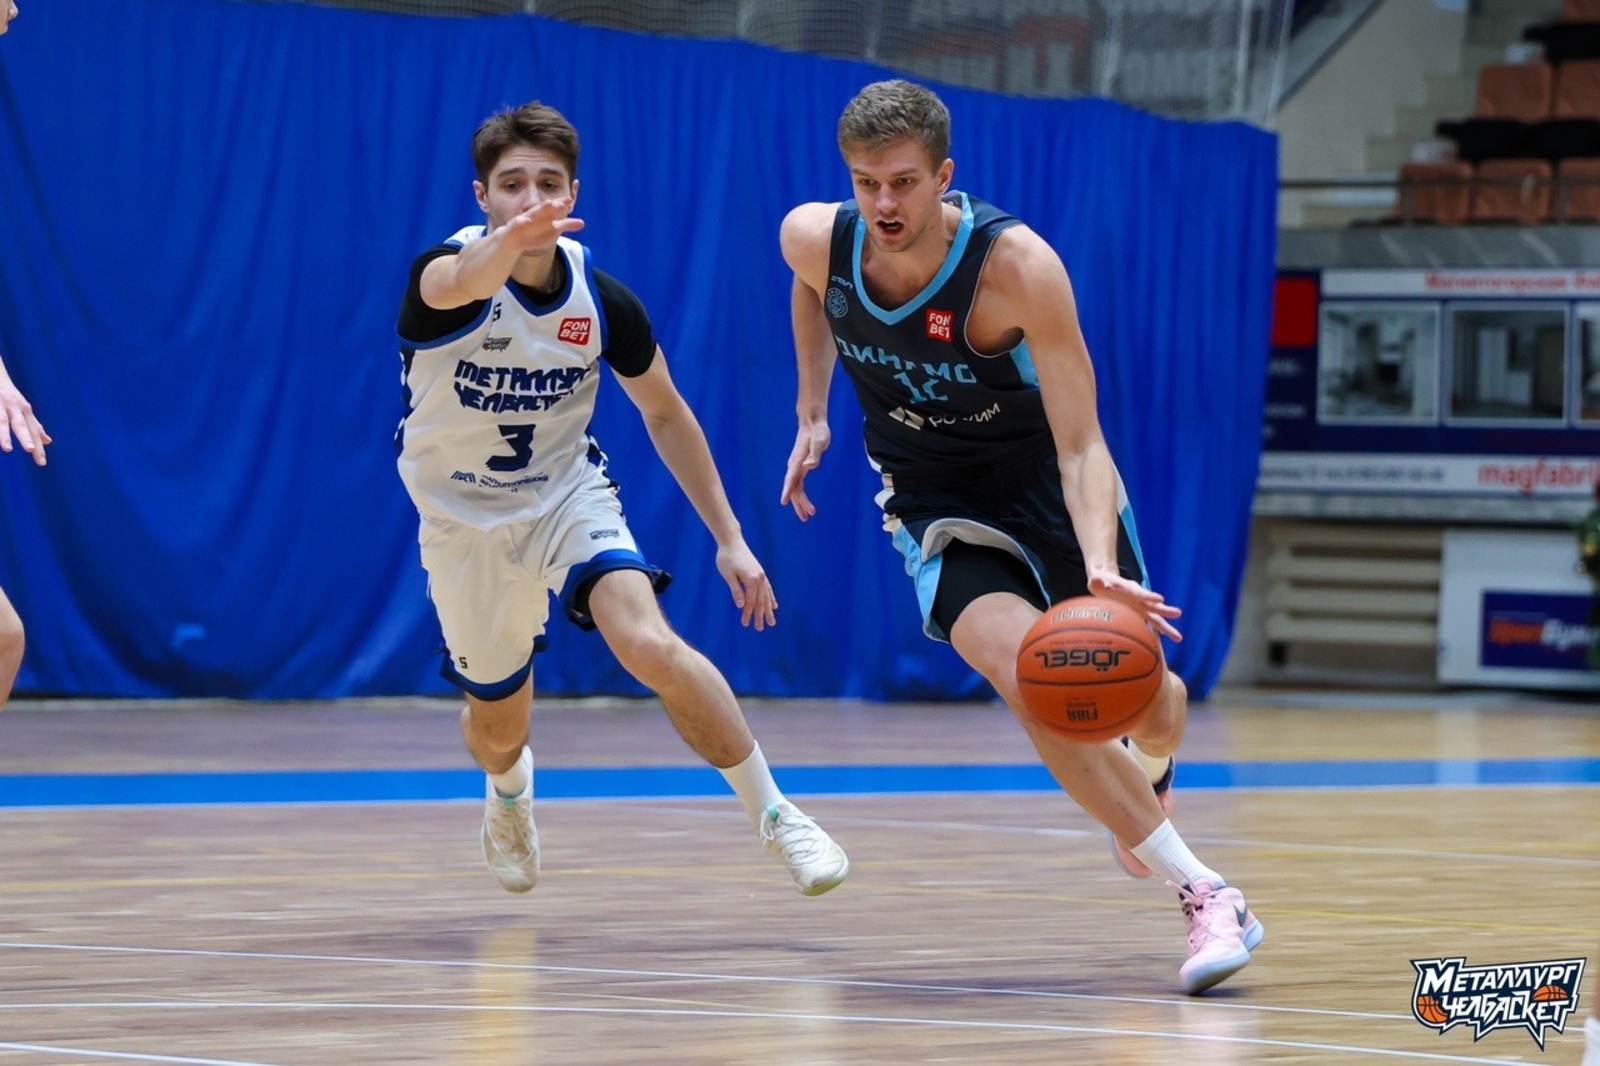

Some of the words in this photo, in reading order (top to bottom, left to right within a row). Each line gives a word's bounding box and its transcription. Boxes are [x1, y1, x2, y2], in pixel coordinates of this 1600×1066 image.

[929, 312, 951, 326] FON
[561, 321, 589, 332] FON
[929, 324, 951, 339] BET
[560, 330, 588, 342] BET
[485, 424, 537, 472] 3
[1034, 648, 1131, 672] JÖGEL
